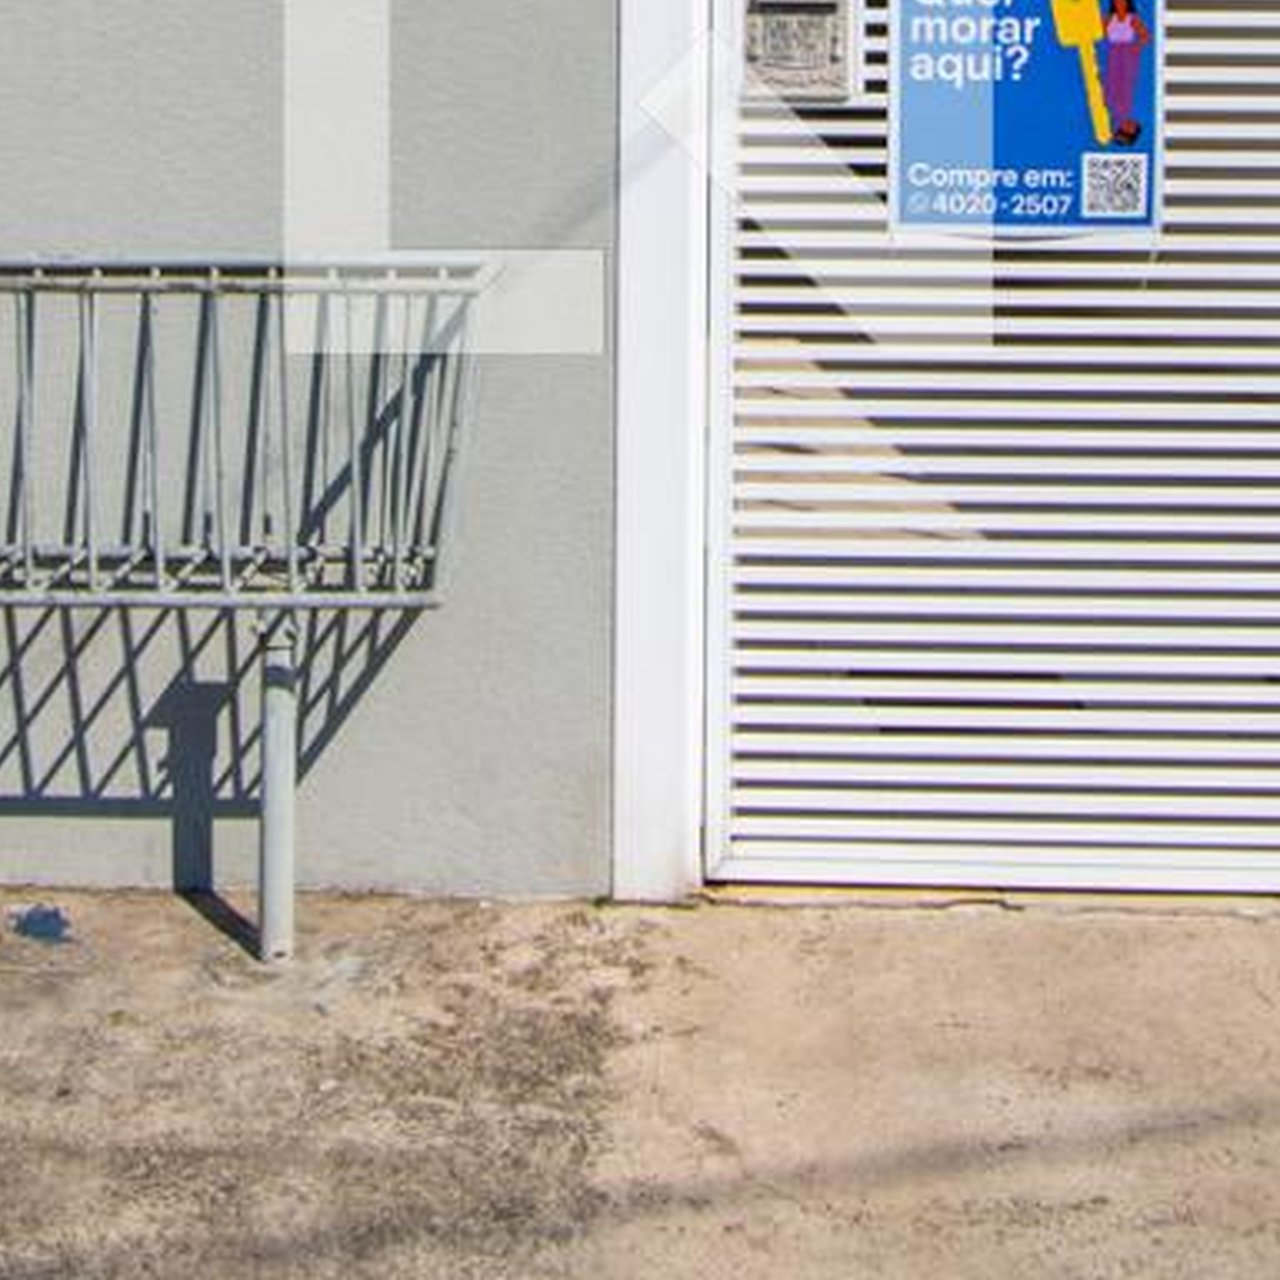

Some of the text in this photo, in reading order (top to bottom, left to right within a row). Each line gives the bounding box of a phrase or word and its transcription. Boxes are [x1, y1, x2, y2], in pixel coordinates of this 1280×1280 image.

[911, 17, 1040, 45] morar
[910, 47, 1029, 89] aqui?
[908, 162, 1073, 190] Compre em:
